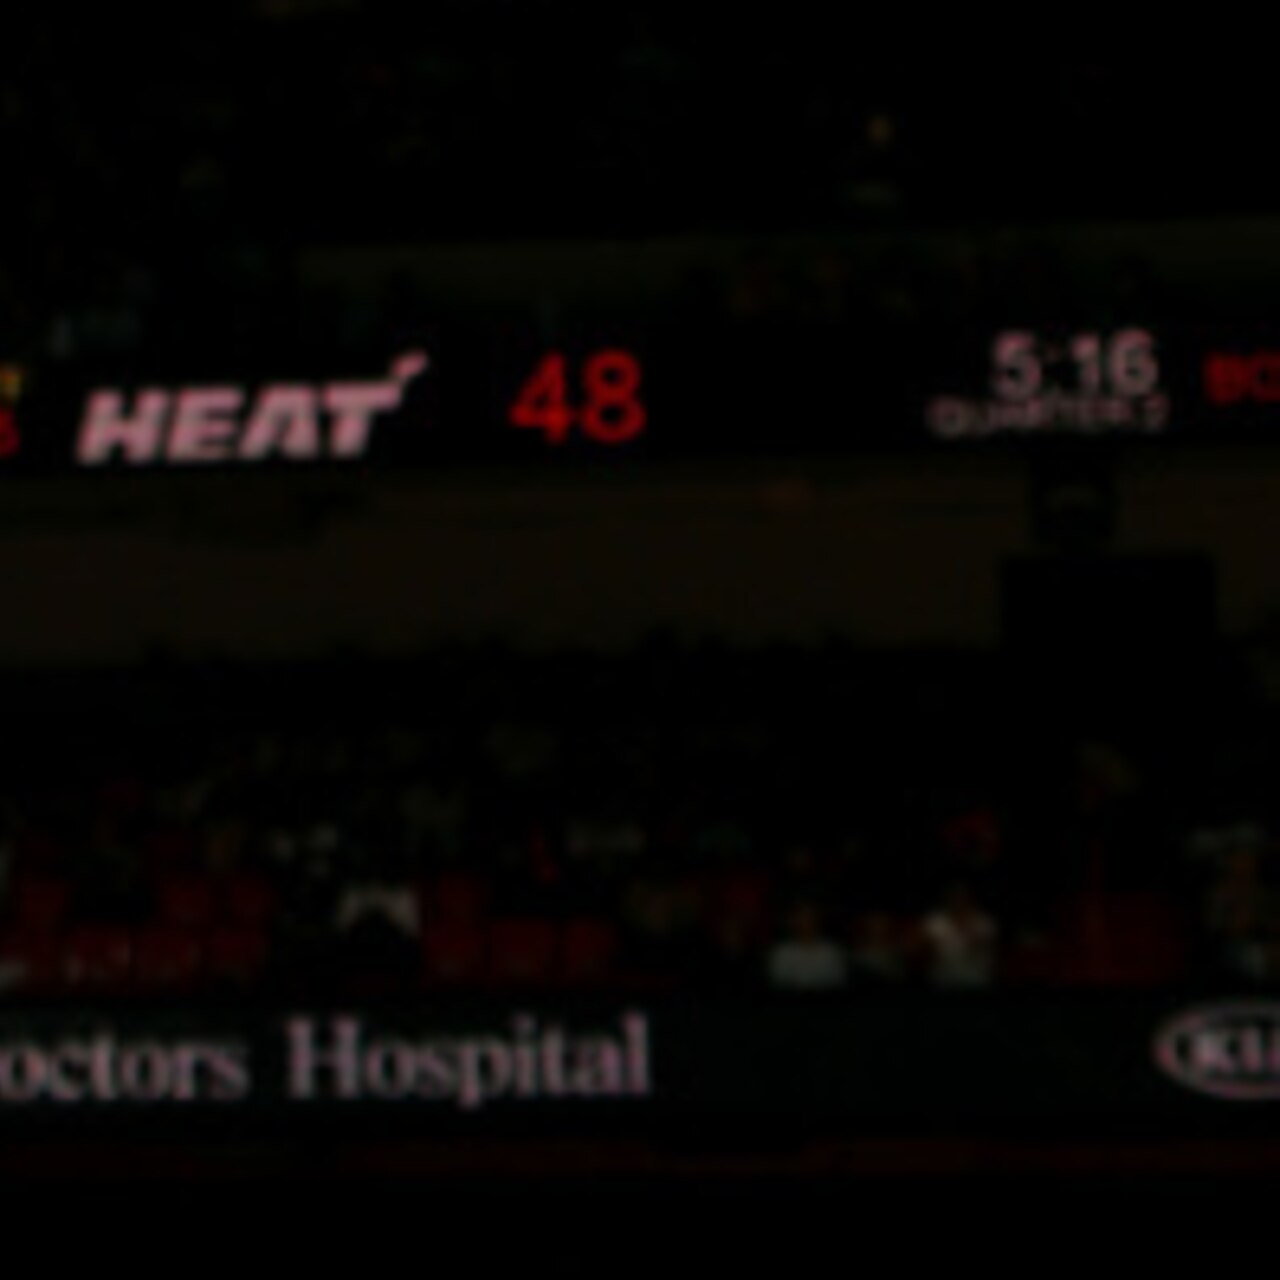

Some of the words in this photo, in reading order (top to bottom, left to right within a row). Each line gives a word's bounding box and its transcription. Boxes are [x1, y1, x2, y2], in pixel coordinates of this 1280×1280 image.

[508, 346, 650, 448] 48
[986, 326, 1162, 400] 5:16
[72, 360, 428, 468] HEAT
[282, 1012, 652, 1112] Hospital
